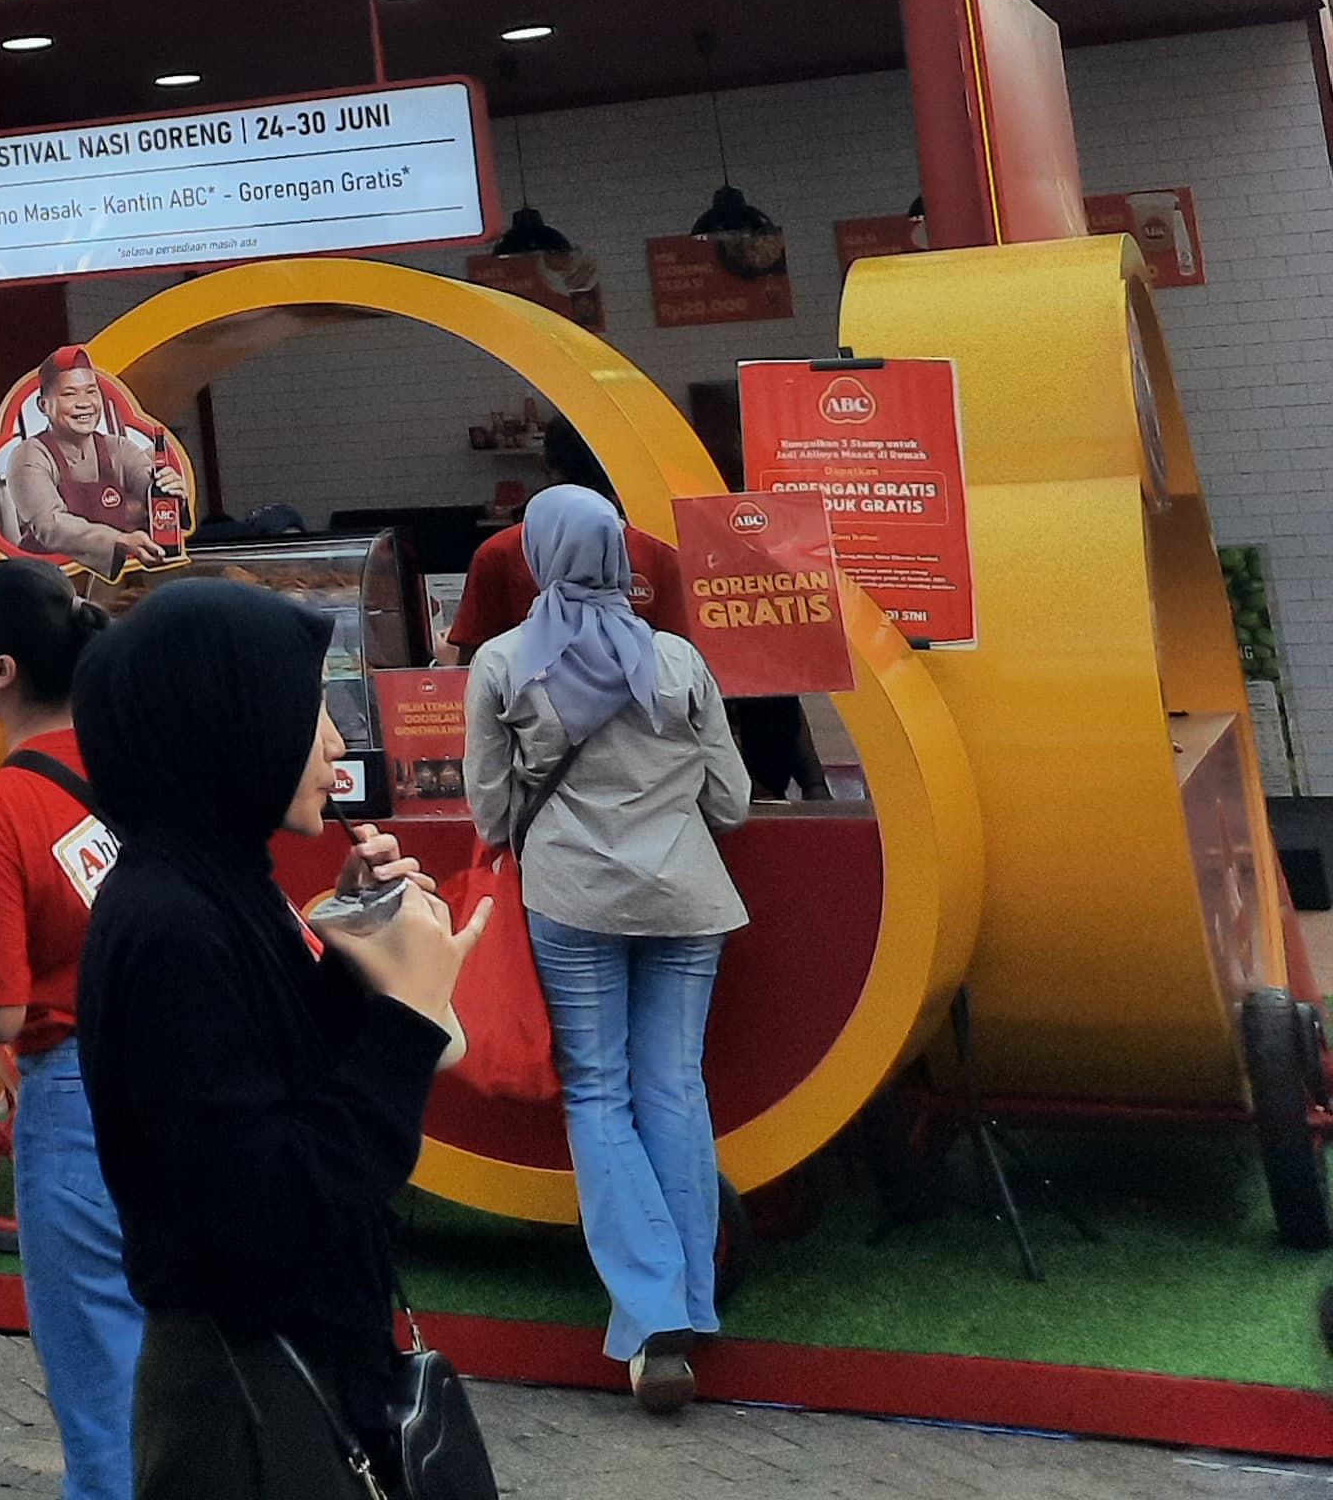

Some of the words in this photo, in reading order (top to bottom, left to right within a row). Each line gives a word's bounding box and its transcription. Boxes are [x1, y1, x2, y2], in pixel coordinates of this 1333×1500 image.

[78, 129, 132, 159] NASI
[137, 121, 233, 154] GORENG
[255, 109, 327, 142] 24-30
[334, 102, 391, 132] JUNI
[24, 198, 83, 223] Masak
[102, 188, 164, 215] Kantin
[238, 177, 335, 206] Gorengan
[825, 397, 871, 414] ABC
[850, 439, 884, 449] Stamp
[873, 482, 936, 498] GRATIS
[824, 498, 857, 513] DUK
[860, 499, 923, 514] GRATIS
[155, 510, 174, 521] ABC
[733, 514, 766, 528] ABC
[692, 570, 830, 599] GORENGAN
[698, 593, 833, 630] GRATIS
[333, 778, 351, 790] BC
[78, 828, 120, 881] Ahl
